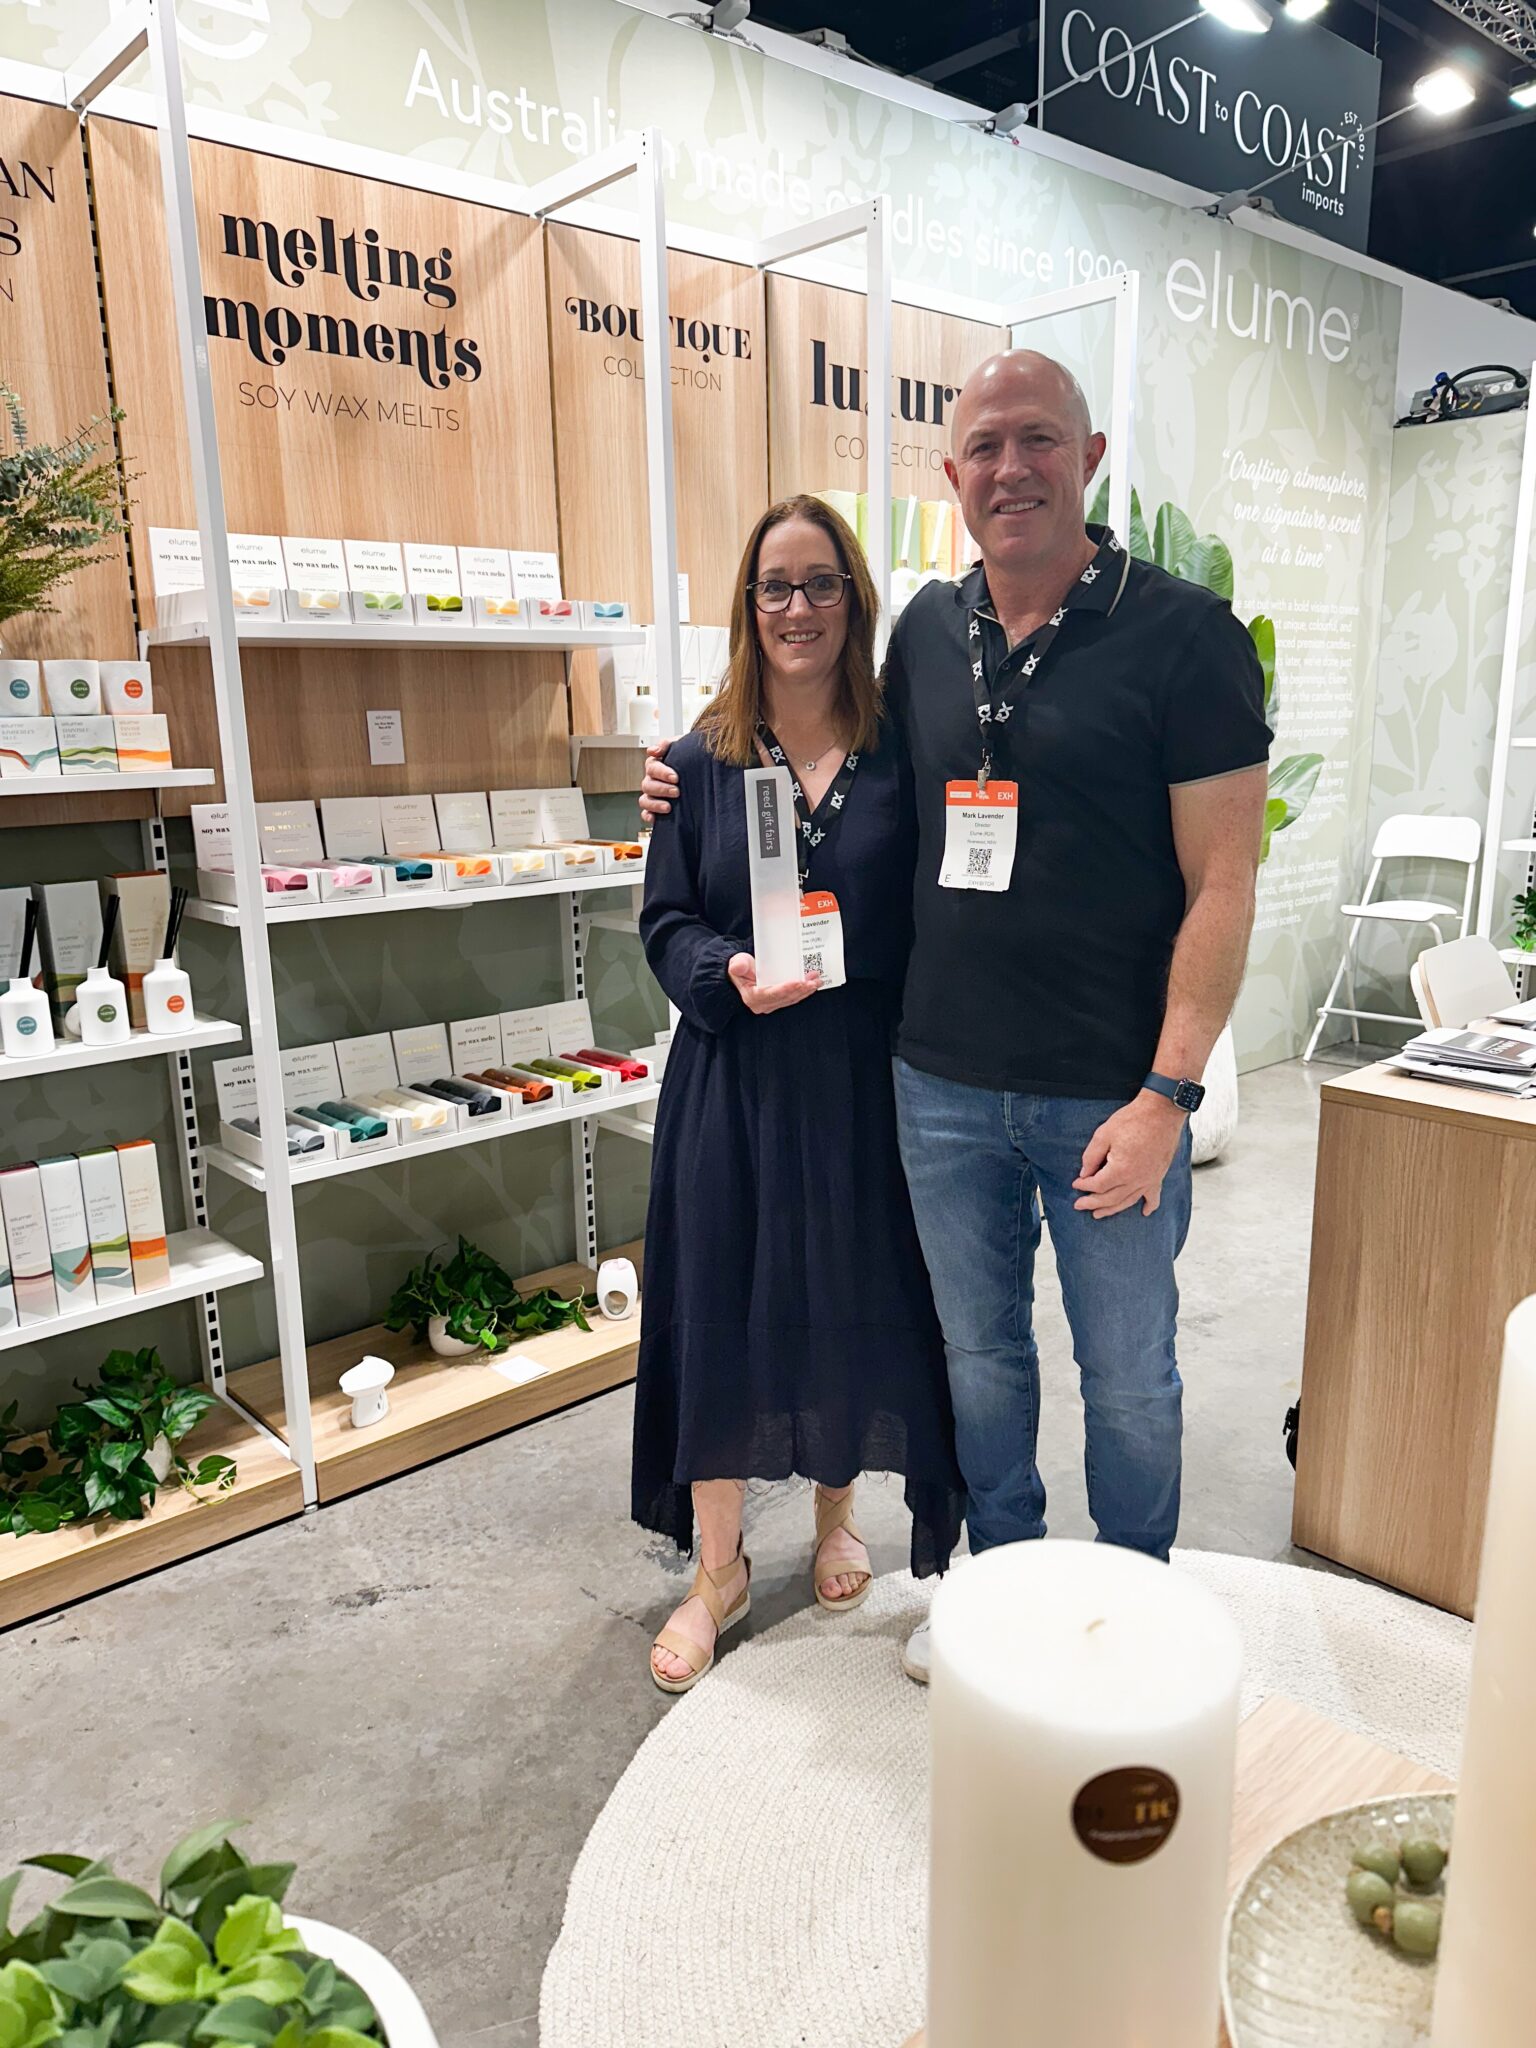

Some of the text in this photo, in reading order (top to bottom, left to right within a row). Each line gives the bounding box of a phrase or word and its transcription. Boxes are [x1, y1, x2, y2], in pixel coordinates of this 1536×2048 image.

[1061, 9, 1356, 195] COAST to COAST
[404, 47, 677, 180] Australin
[696, 149, 810, 216] made
[826, 190, 963, 258] cdles
[975, 225, 1054, 283] since
[1302, 182, 1344, 216] imports
[219, 213, 457, 309] melting
[1164, 249, 1352, 363] elume
[565, 296, 752, 363] BOUIQUE
[203, 295, 482, 390] moments
[603, 355, 722, 392] COLCTION
[810, 338, 963, 426] luur
[239, 381, 460, 431] SOY WAX MELTS
[1234, 502, 1361, 535] one signature scent
[174, 553, 189, 561] wax
[258, 558, 277, 566] melts
[1261, 542, 1278, 563] at
[1280, 549, 1292, 564] a
[305, 561, 320, 569] wax
[321, 562, 340, 570] melts
[1080, 564, 1101, 584] RX
[1049, 607, 1069, 627] RX
[969, 618, 980, 640] RX
[972, 659, 983, 682] RX
[1021, 653, 1040, 676] RX
[978, 703, 992, 725] RX
[994, 701, 1014, 723] RX
[770, 745, 786, 763] RX
[830, 790, 845, 810] RX
[997, 791, 1013, 800] EXH
[761, 785, 776, 851] reed gift fairs
[977, 812, 1004, 820] Lavender
[817, 899, 834, 908] EXH
[802, 919, 830, 929] Lavender
